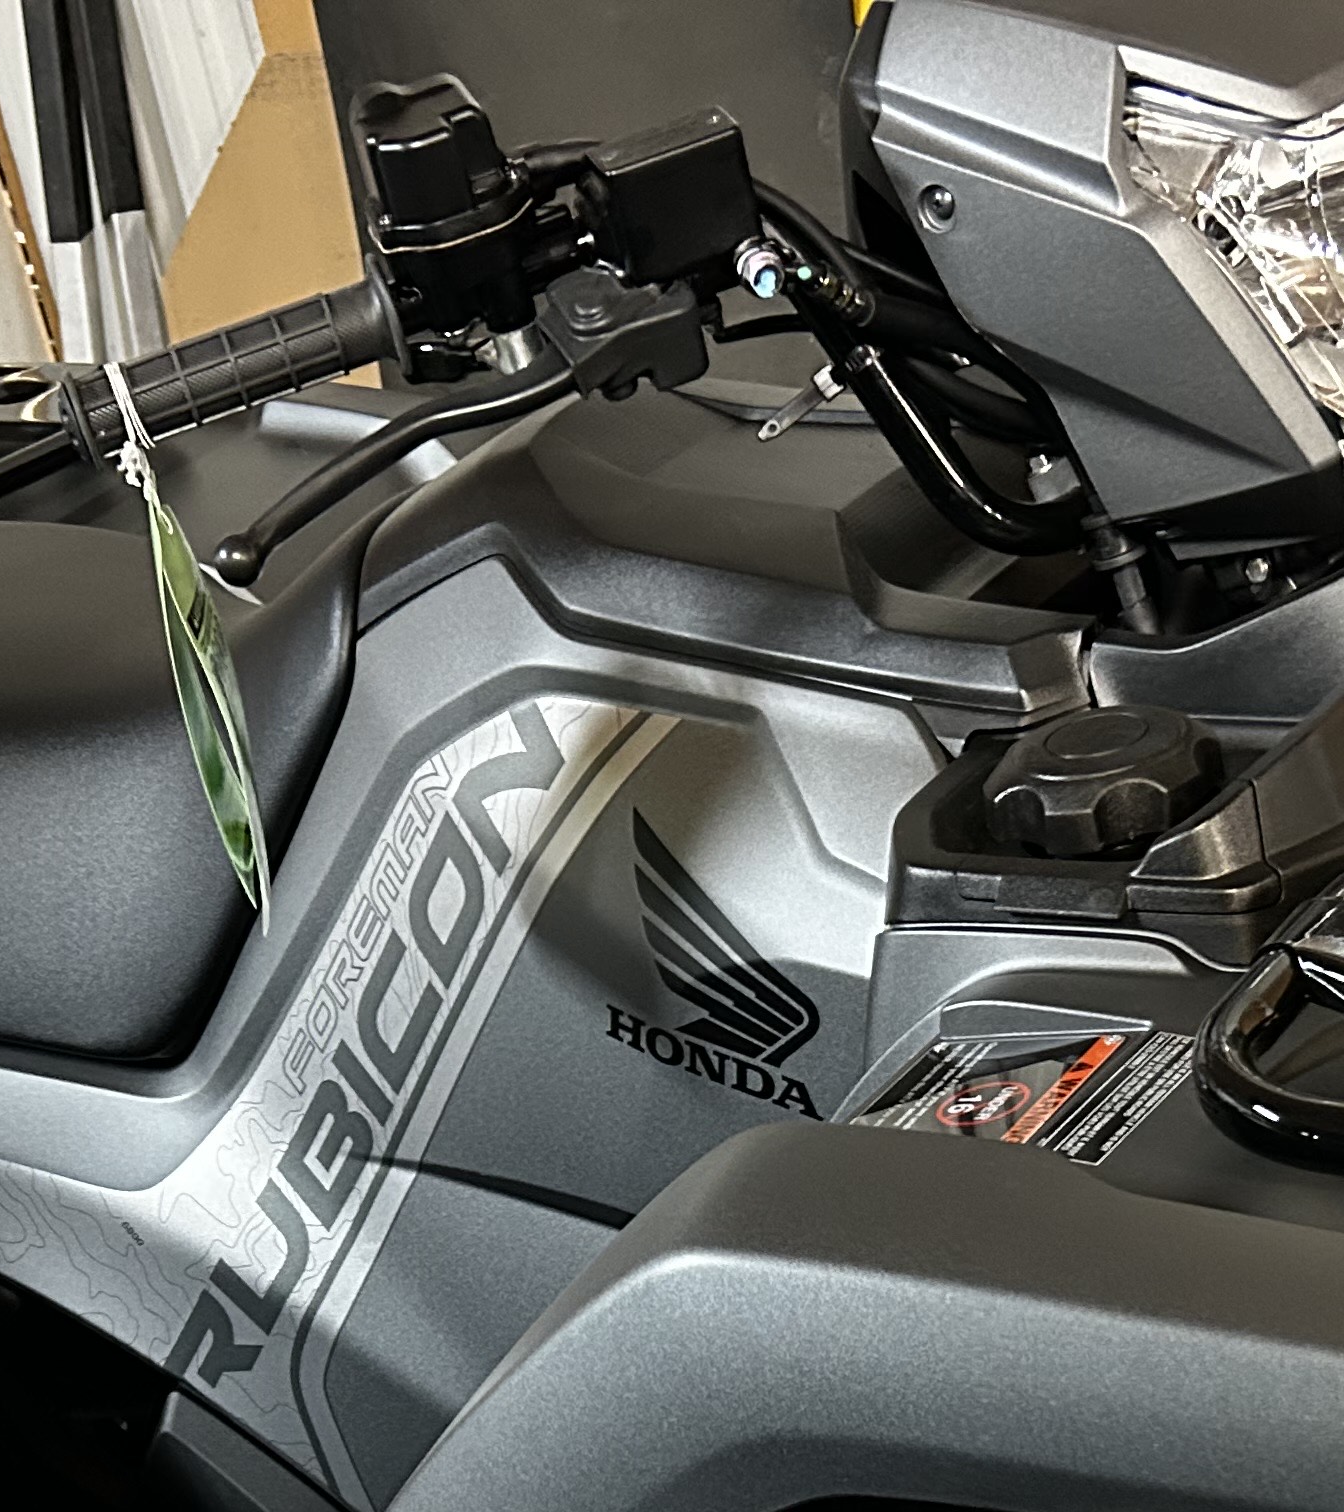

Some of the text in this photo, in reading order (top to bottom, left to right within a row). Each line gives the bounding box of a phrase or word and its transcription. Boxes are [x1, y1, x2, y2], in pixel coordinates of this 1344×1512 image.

[282, 752, 453, 1097] FOREMAN
[163, 702, 565, 1388] RUBICON
[604, 1004, 824, 1121] HONDA
[947, 1094, 983, 1114] 16
[973, 1086, 1019, 1121] UNDER
[1005, 1078, 1083, 1144] WARNING
